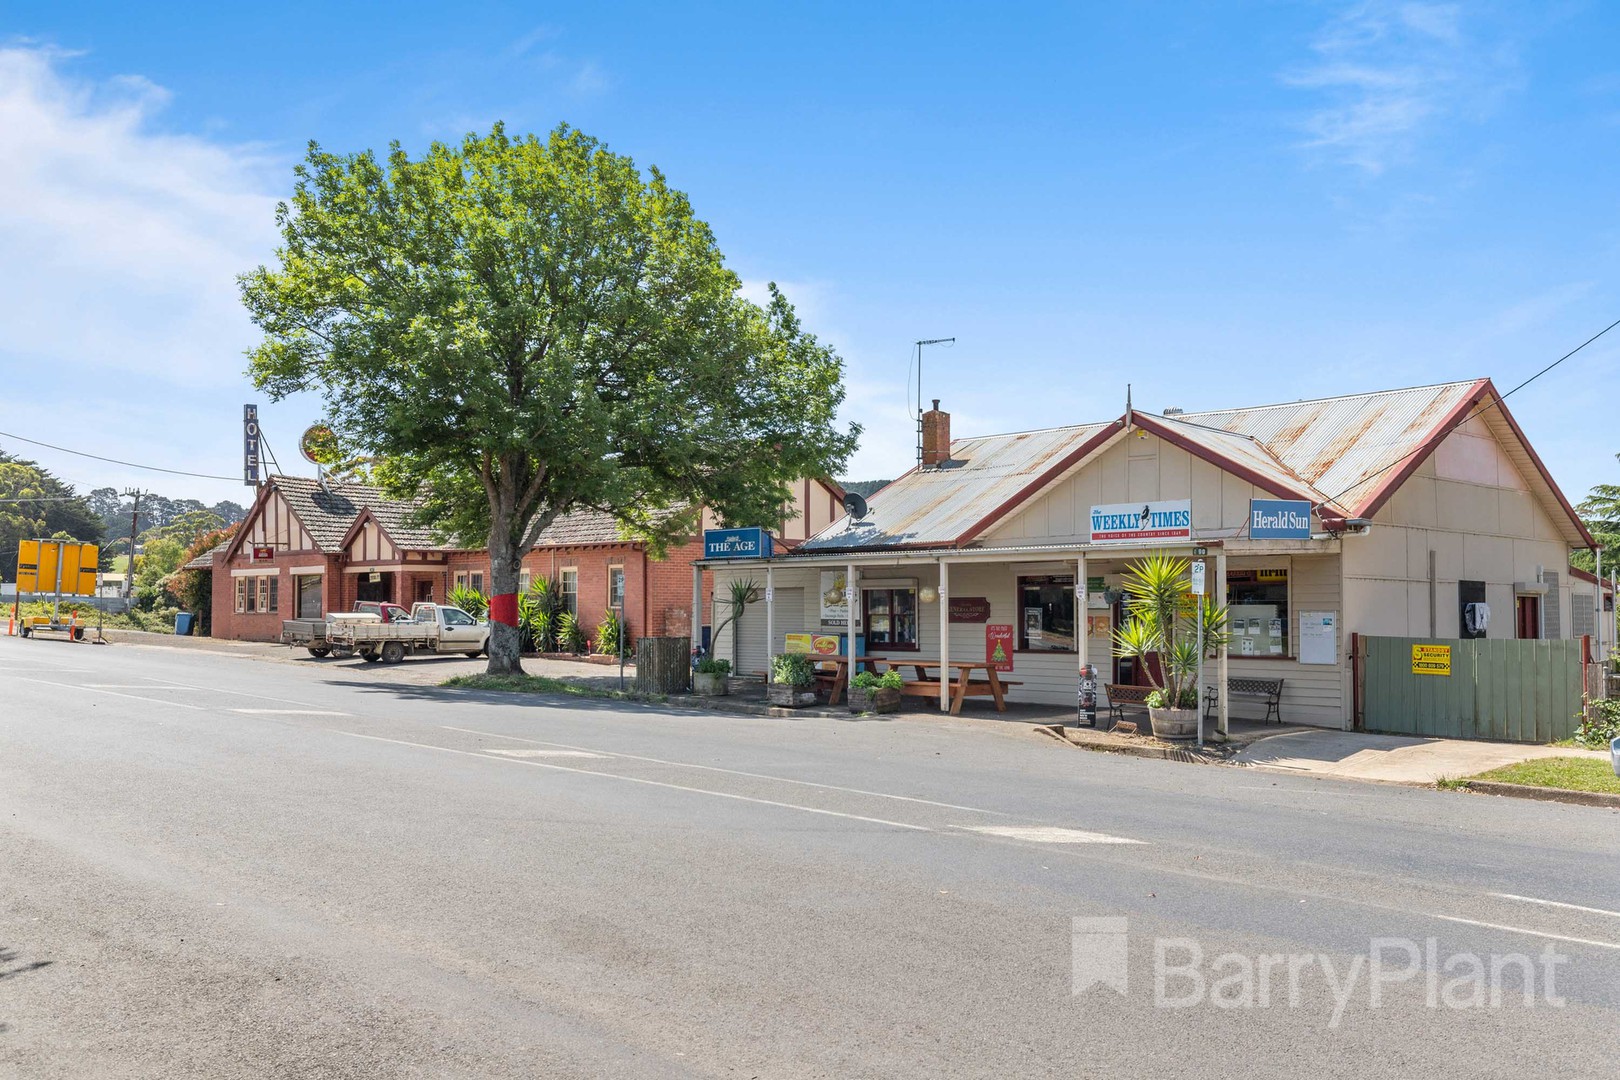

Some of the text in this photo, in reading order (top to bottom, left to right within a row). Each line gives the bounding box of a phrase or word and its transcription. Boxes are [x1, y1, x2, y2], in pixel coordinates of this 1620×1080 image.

[246, 408, 258, 481] HOTEL
[1092, 510, 1190, 531] WEEKLY TIMES
[1252, 510, 1309, 529] Herald Sun
[709, 541, 756, 552] THE AGE
[1194, 565, 1204, 573] 2P
